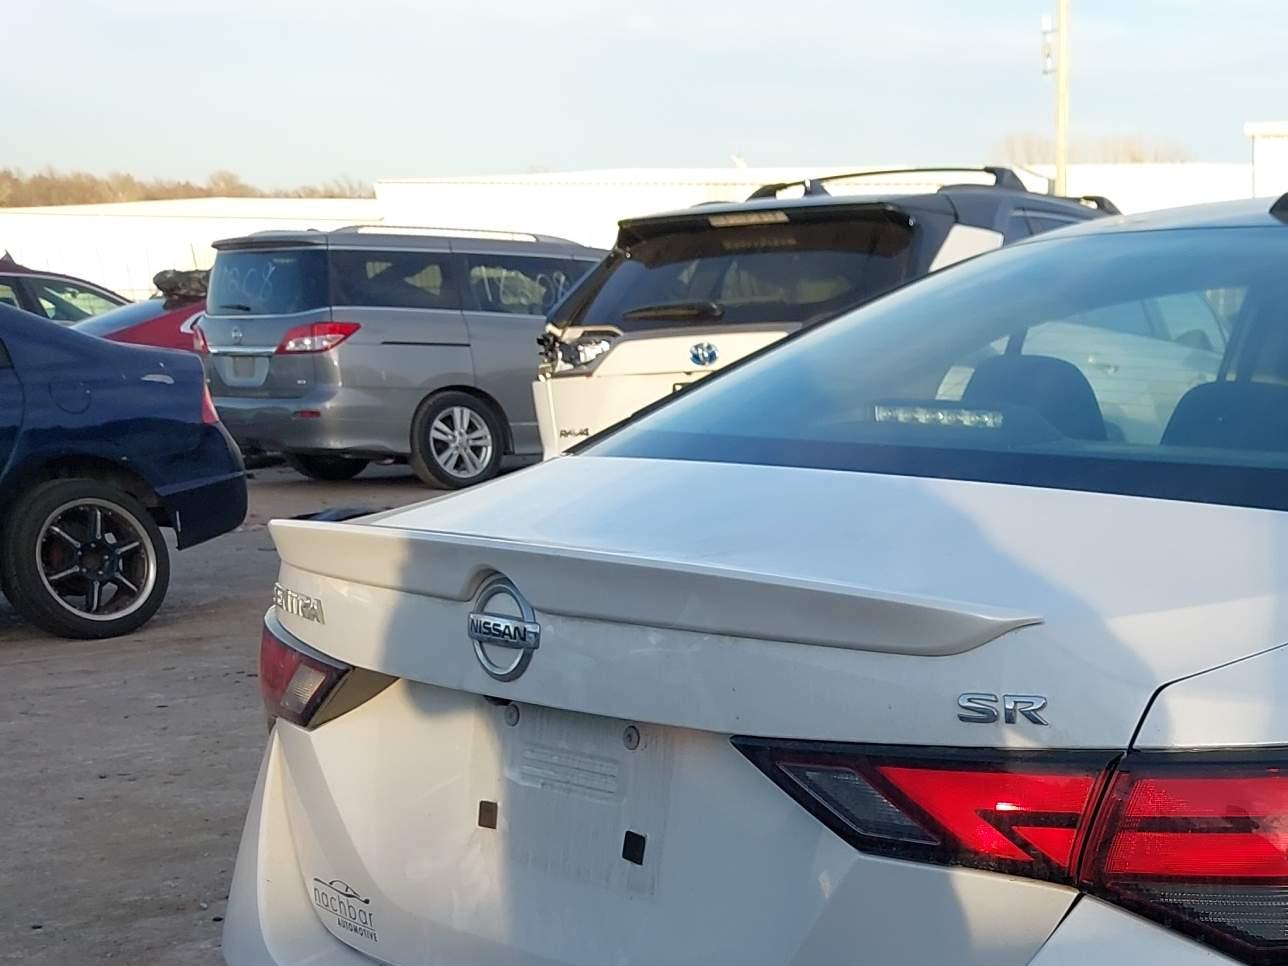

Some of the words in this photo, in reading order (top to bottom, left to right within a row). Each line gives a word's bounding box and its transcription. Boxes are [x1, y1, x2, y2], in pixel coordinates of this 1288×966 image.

[470, 618, 526, 642] NISSAN
[957, 692, 1049, 726] SR
[313, 887, 373, 928] nachbar
[337, 917, 379, 943] AUTOMOTIVE
